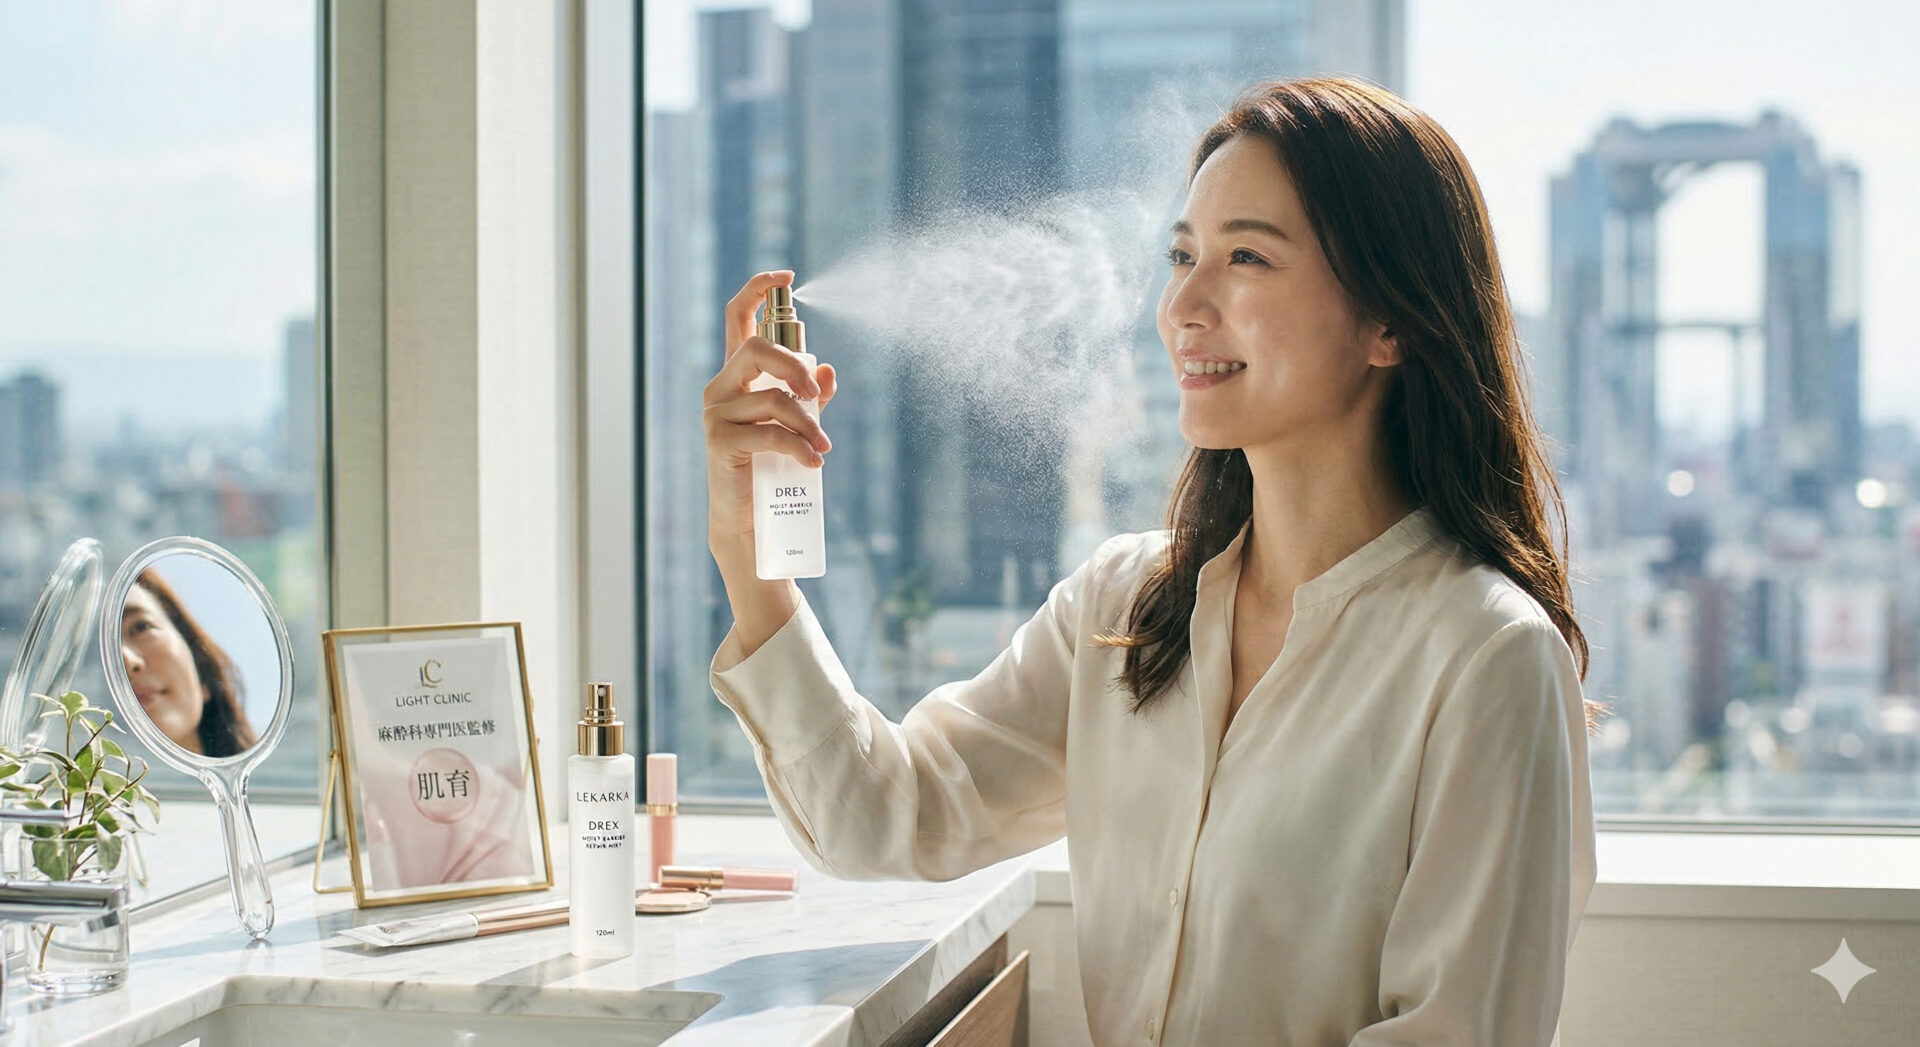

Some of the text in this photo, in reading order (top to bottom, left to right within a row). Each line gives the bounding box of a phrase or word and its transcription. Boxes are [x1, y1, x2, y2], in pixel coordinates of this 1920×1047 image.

[775, 486, 807, 498] DREX
[396, 692, 473, 708] LIGHT CLINIC
[417, 769, 471, 801] 肌育
[576, 791, 630, 803] LEKARKA
[588, 820, 619, 831] DREX
